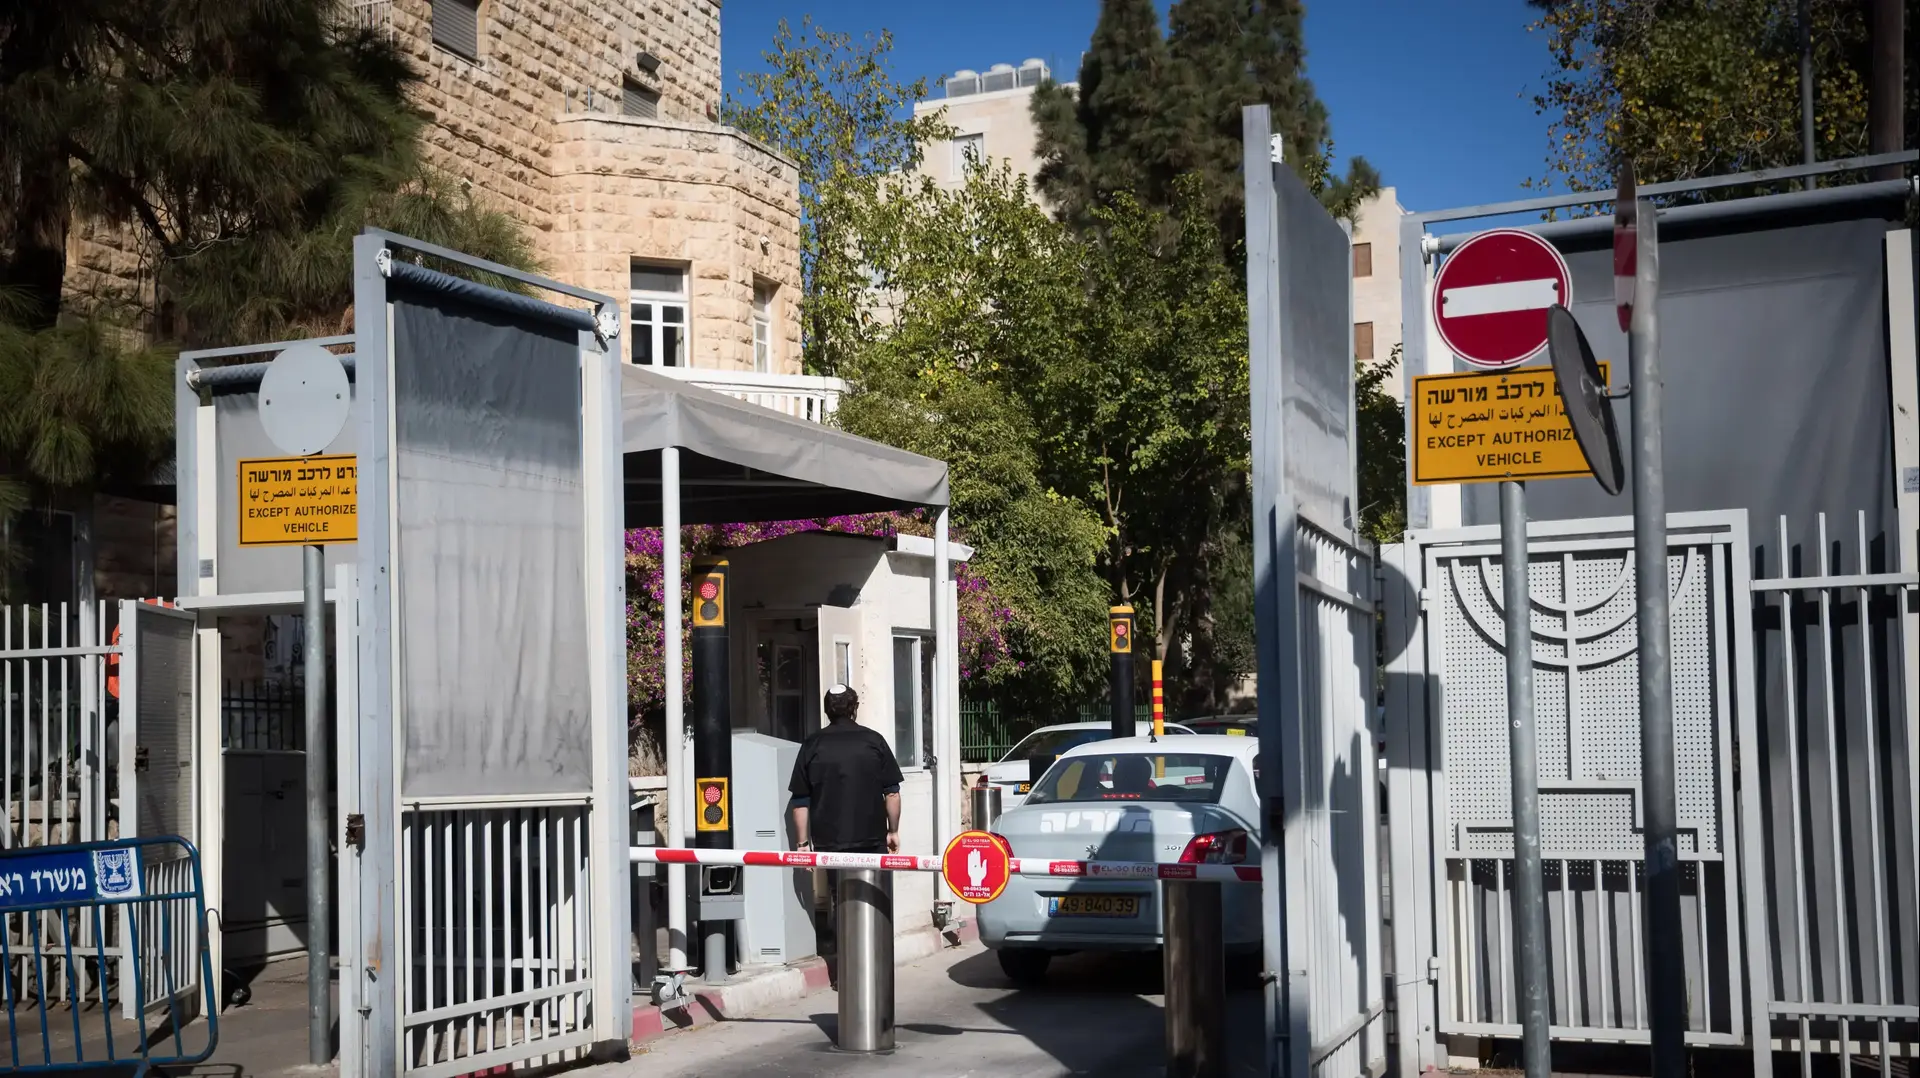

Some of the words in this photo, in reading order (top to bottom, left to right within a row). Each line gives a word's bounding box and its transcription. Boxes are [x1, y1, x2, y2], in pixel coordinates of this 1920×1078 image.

[1427, 386, 1488, 405] מורשה
[1496, 380, 1544, 400] לרכב
[1427, 433, 1486, 449] EXCEPT
[1492, 428, 1576, 445] AUTHORIZ
[1476, 451, 1542, 467] VEHICLE
[248, 469, 292, 483] מורשה
[297, 466, 330, 481] לרכב
[337, 466, 357, 479] רט
[248, 507, 290, 518] EXCEPT
[294, 504, 356, 516] AUTHORIZE
[284, 522, 328, 533] VEHICLE
[0, 871, 24, 896] רא
[30, 867, 87, 894] משרד
